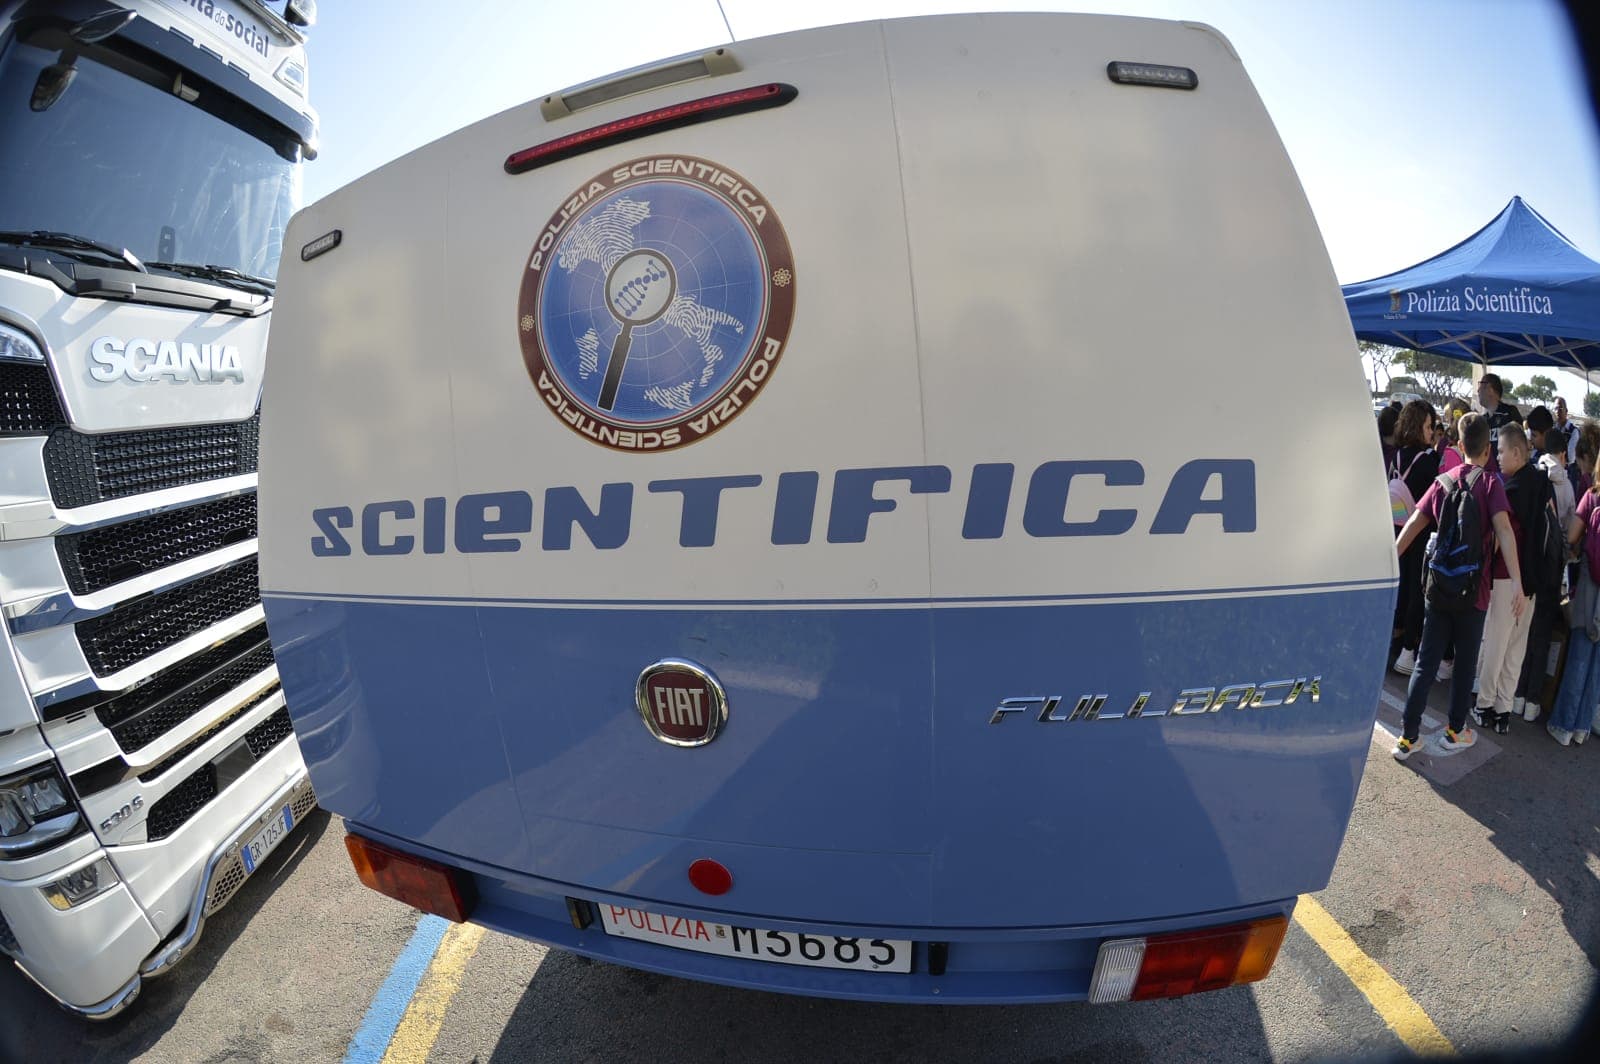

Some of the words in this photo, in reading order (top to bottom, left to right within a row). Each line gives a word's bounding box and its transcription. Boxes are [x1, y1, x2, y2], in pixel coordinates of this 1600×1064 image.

[225, 14, 269, 58] social
[530, 181, 605, 272] POLIZIA
[612, 159, 768, 226] SCIENTIFICA
[1407, 288, 1461, 313] Polizia
[1464, 286, 1553, 315] Scientifica
[90, 336, 245, 383] SCANIA
[687, 336, 781, 435] POLIZIA
[537, 370, 682, 449] SCIENTIFICA
[653, 686, 704, 726] FIAT
[989, 675, 1322, 724] FULLBACK
[610, 904, 711, 942] POLIZIA
